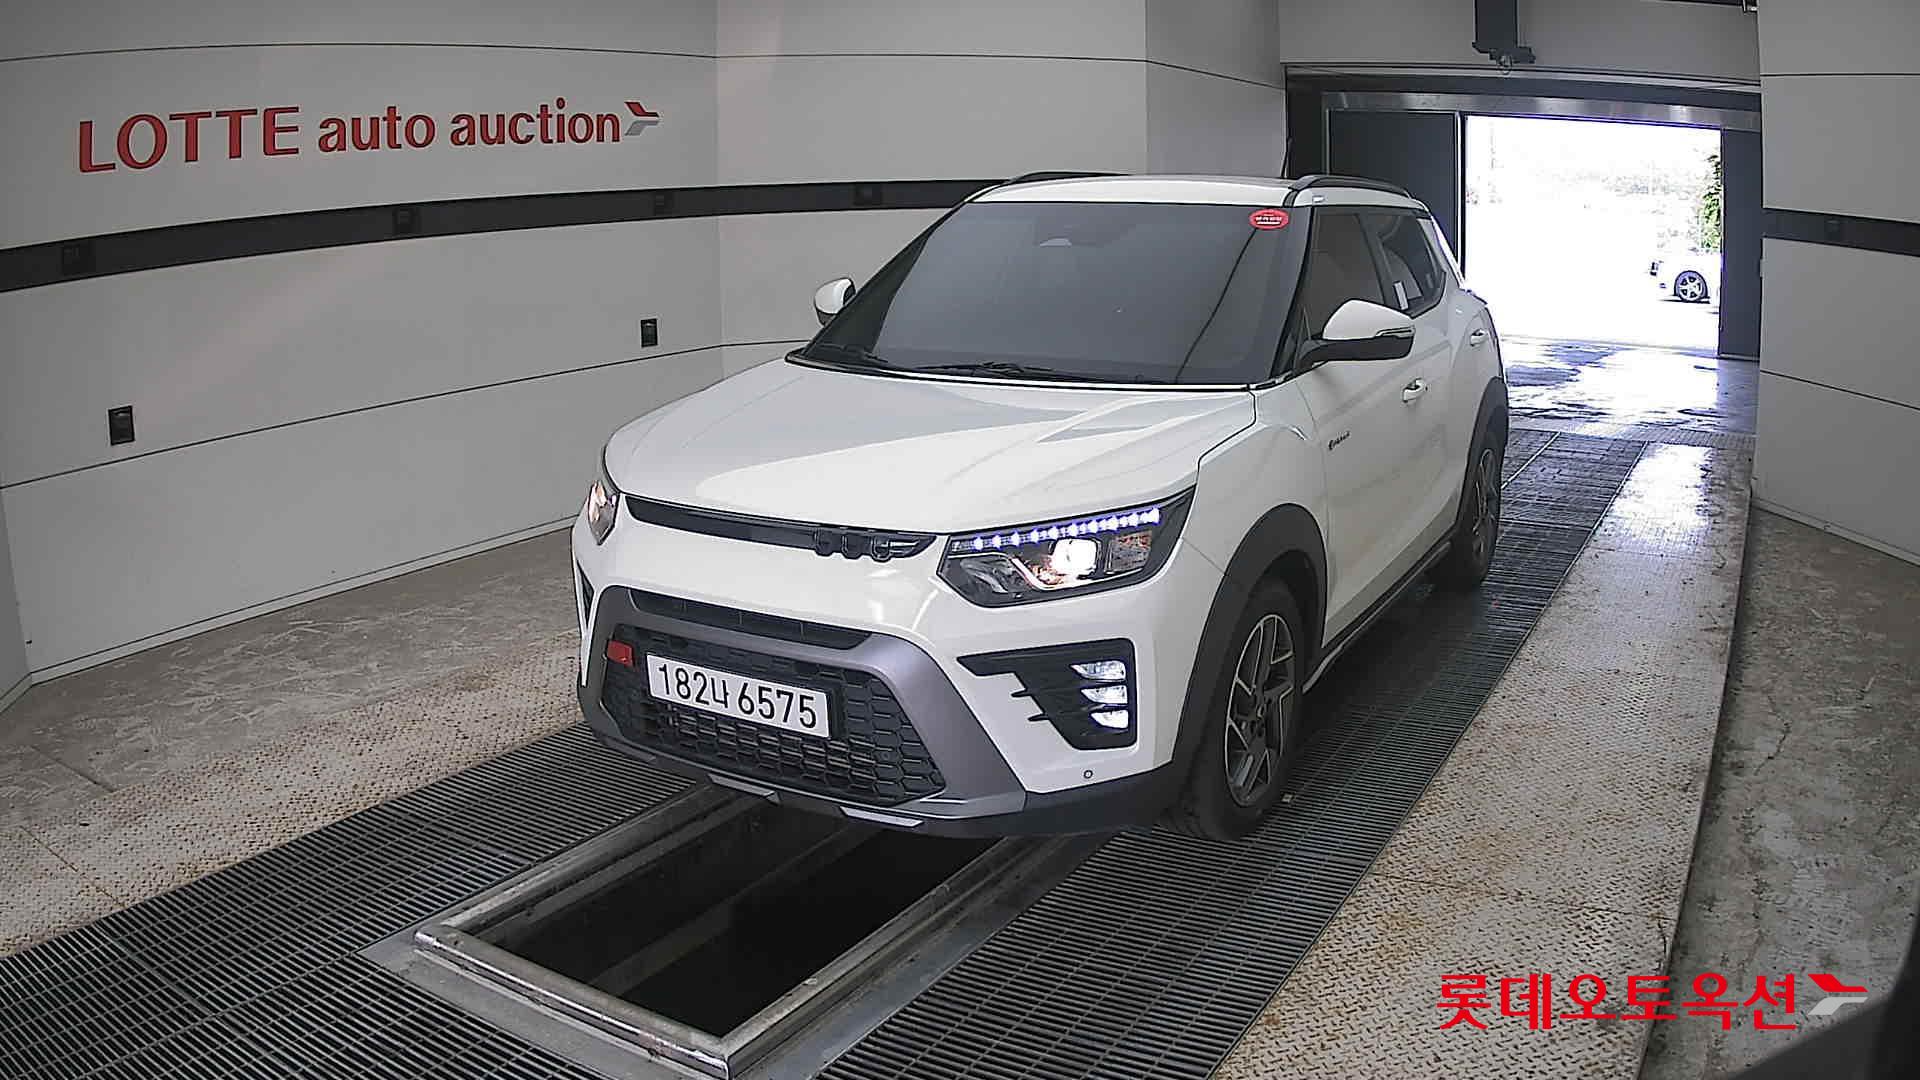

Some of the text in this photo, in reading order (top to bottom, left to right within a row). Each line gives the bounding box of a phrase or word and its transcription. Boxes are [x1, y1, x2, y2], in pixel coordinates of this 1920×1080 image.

[79, 97, 620, 173] LOTTE auto auction
[658, 664, 817, 729] 182나 6575
